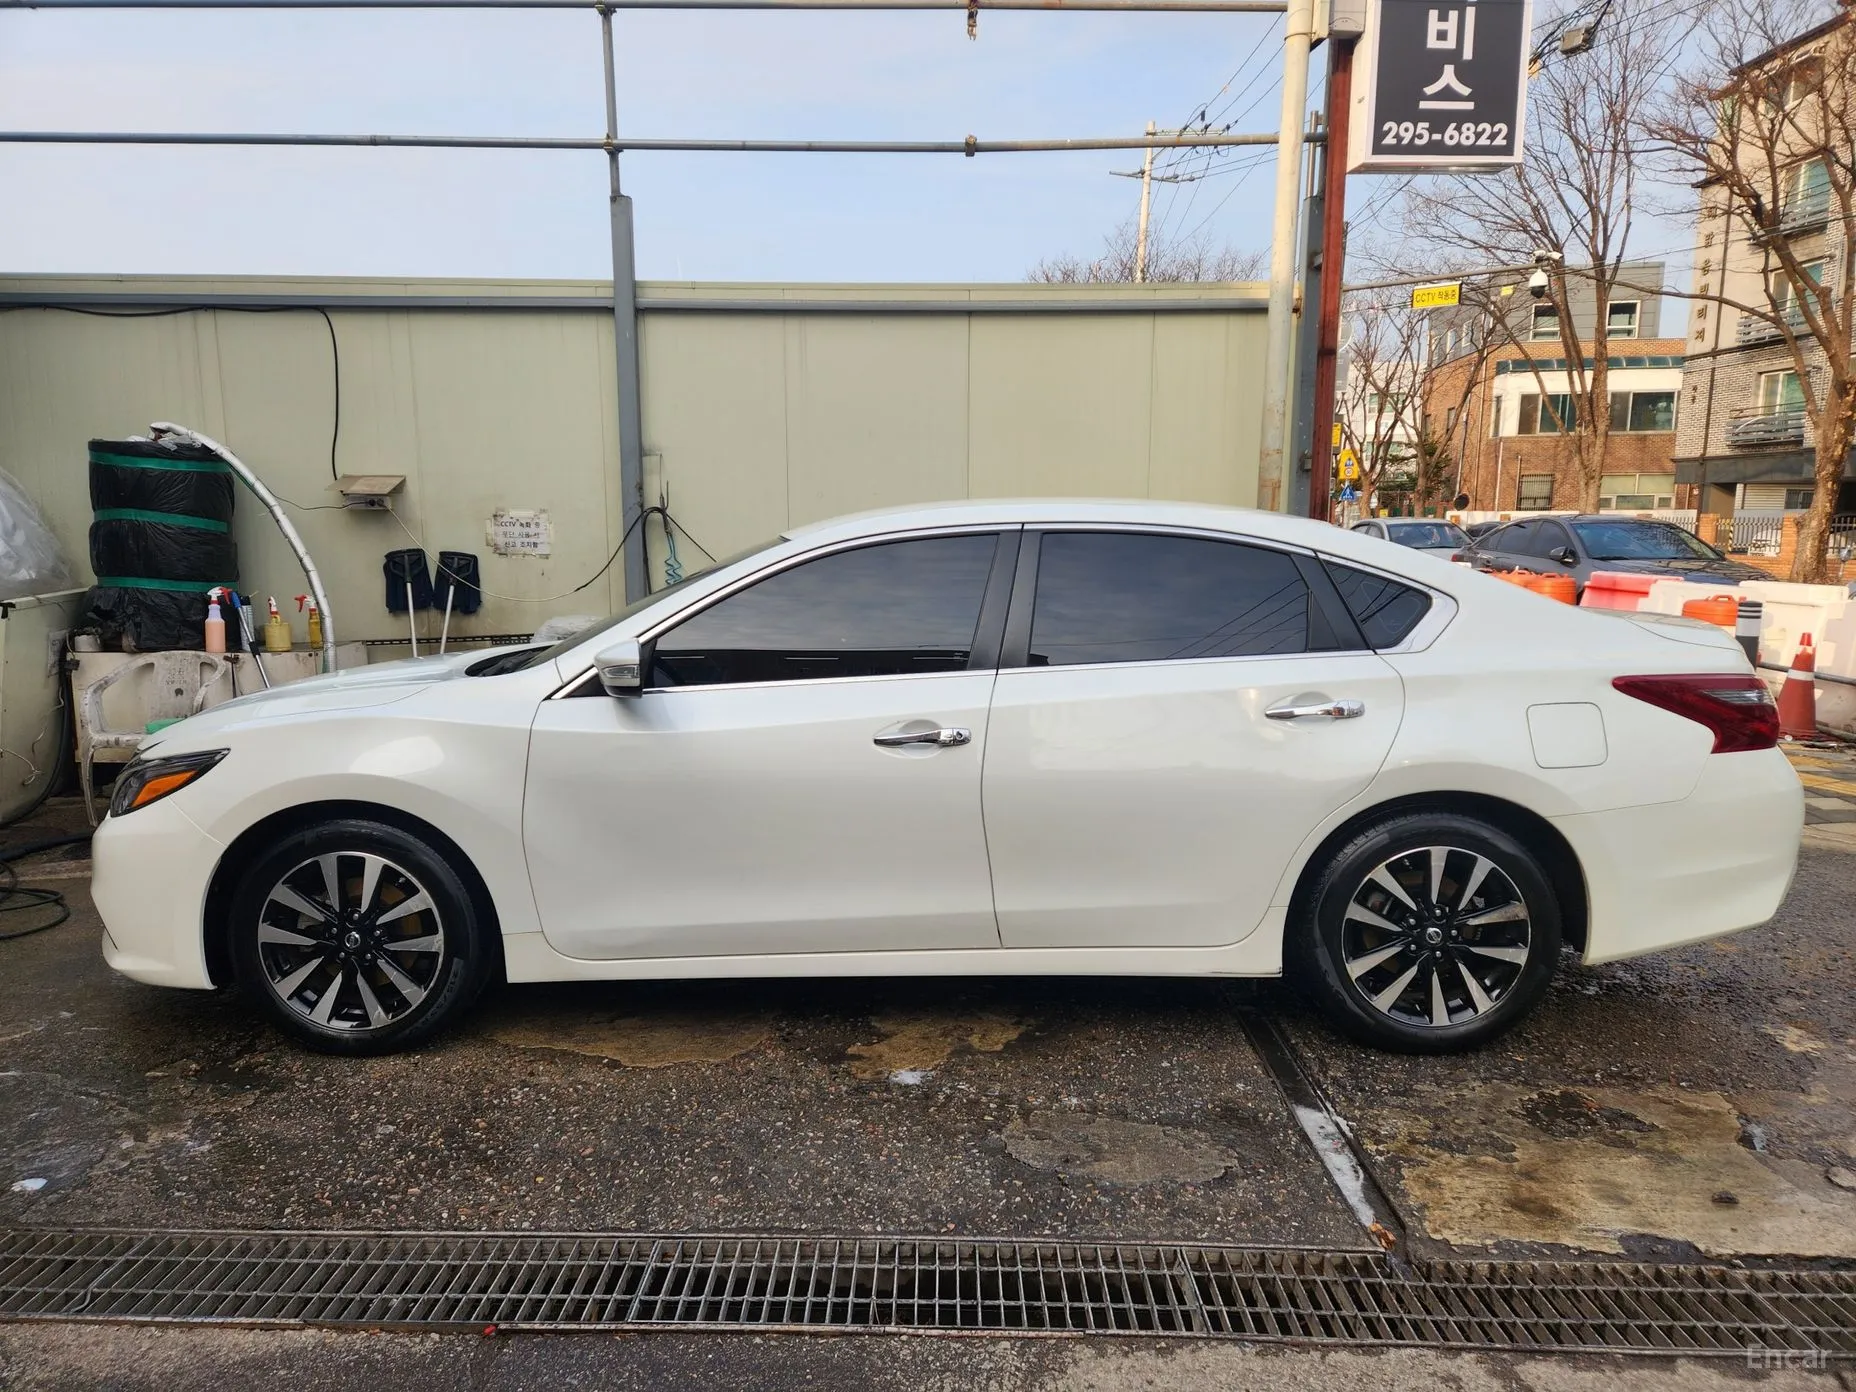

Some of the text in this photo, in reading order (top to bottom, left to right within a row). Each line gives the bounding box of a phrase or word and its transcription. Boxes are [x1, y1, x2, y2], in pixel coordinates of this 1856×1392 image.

[1419, 0, 1477, 110] 비스
[1381, 121, 1508, 146] 295-6822
[1415, 288, 1457, 304] CCTV 작동중
